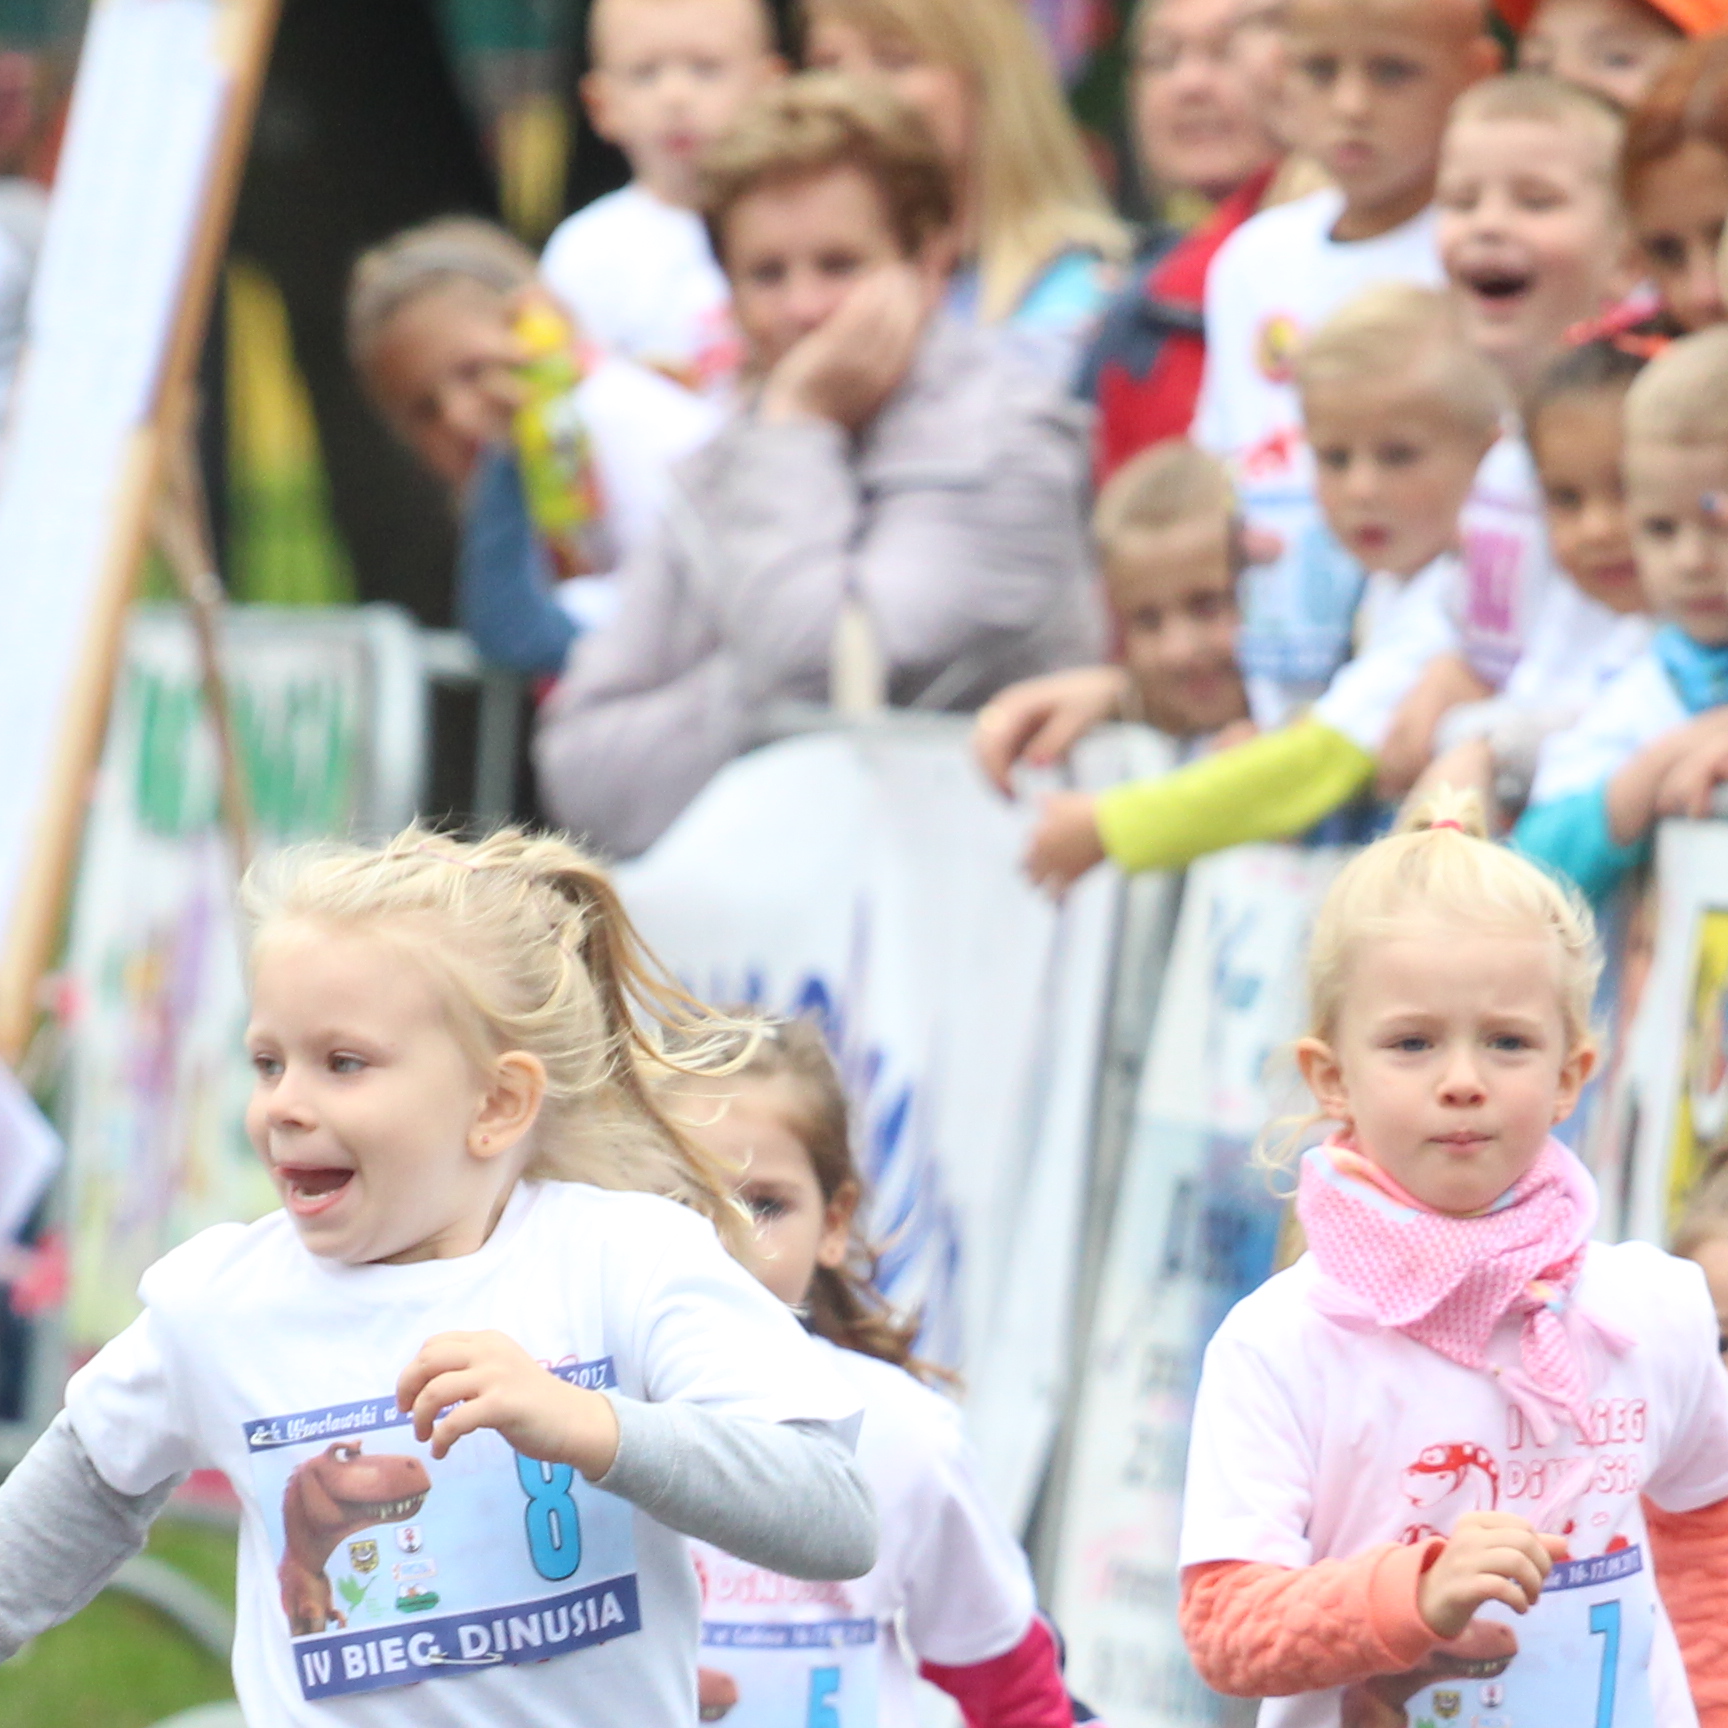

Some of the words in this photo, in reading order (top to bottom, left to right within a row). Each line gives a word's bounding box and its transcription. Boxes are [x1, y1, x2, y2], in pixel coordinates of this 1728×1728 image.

[515, 1447, 581, 1582] 8
[302, 1649, 332, 1687] IV
[343, 1632, 440, 1680] BIEG
[458, 1591, 625, 1660] DINUSIA
